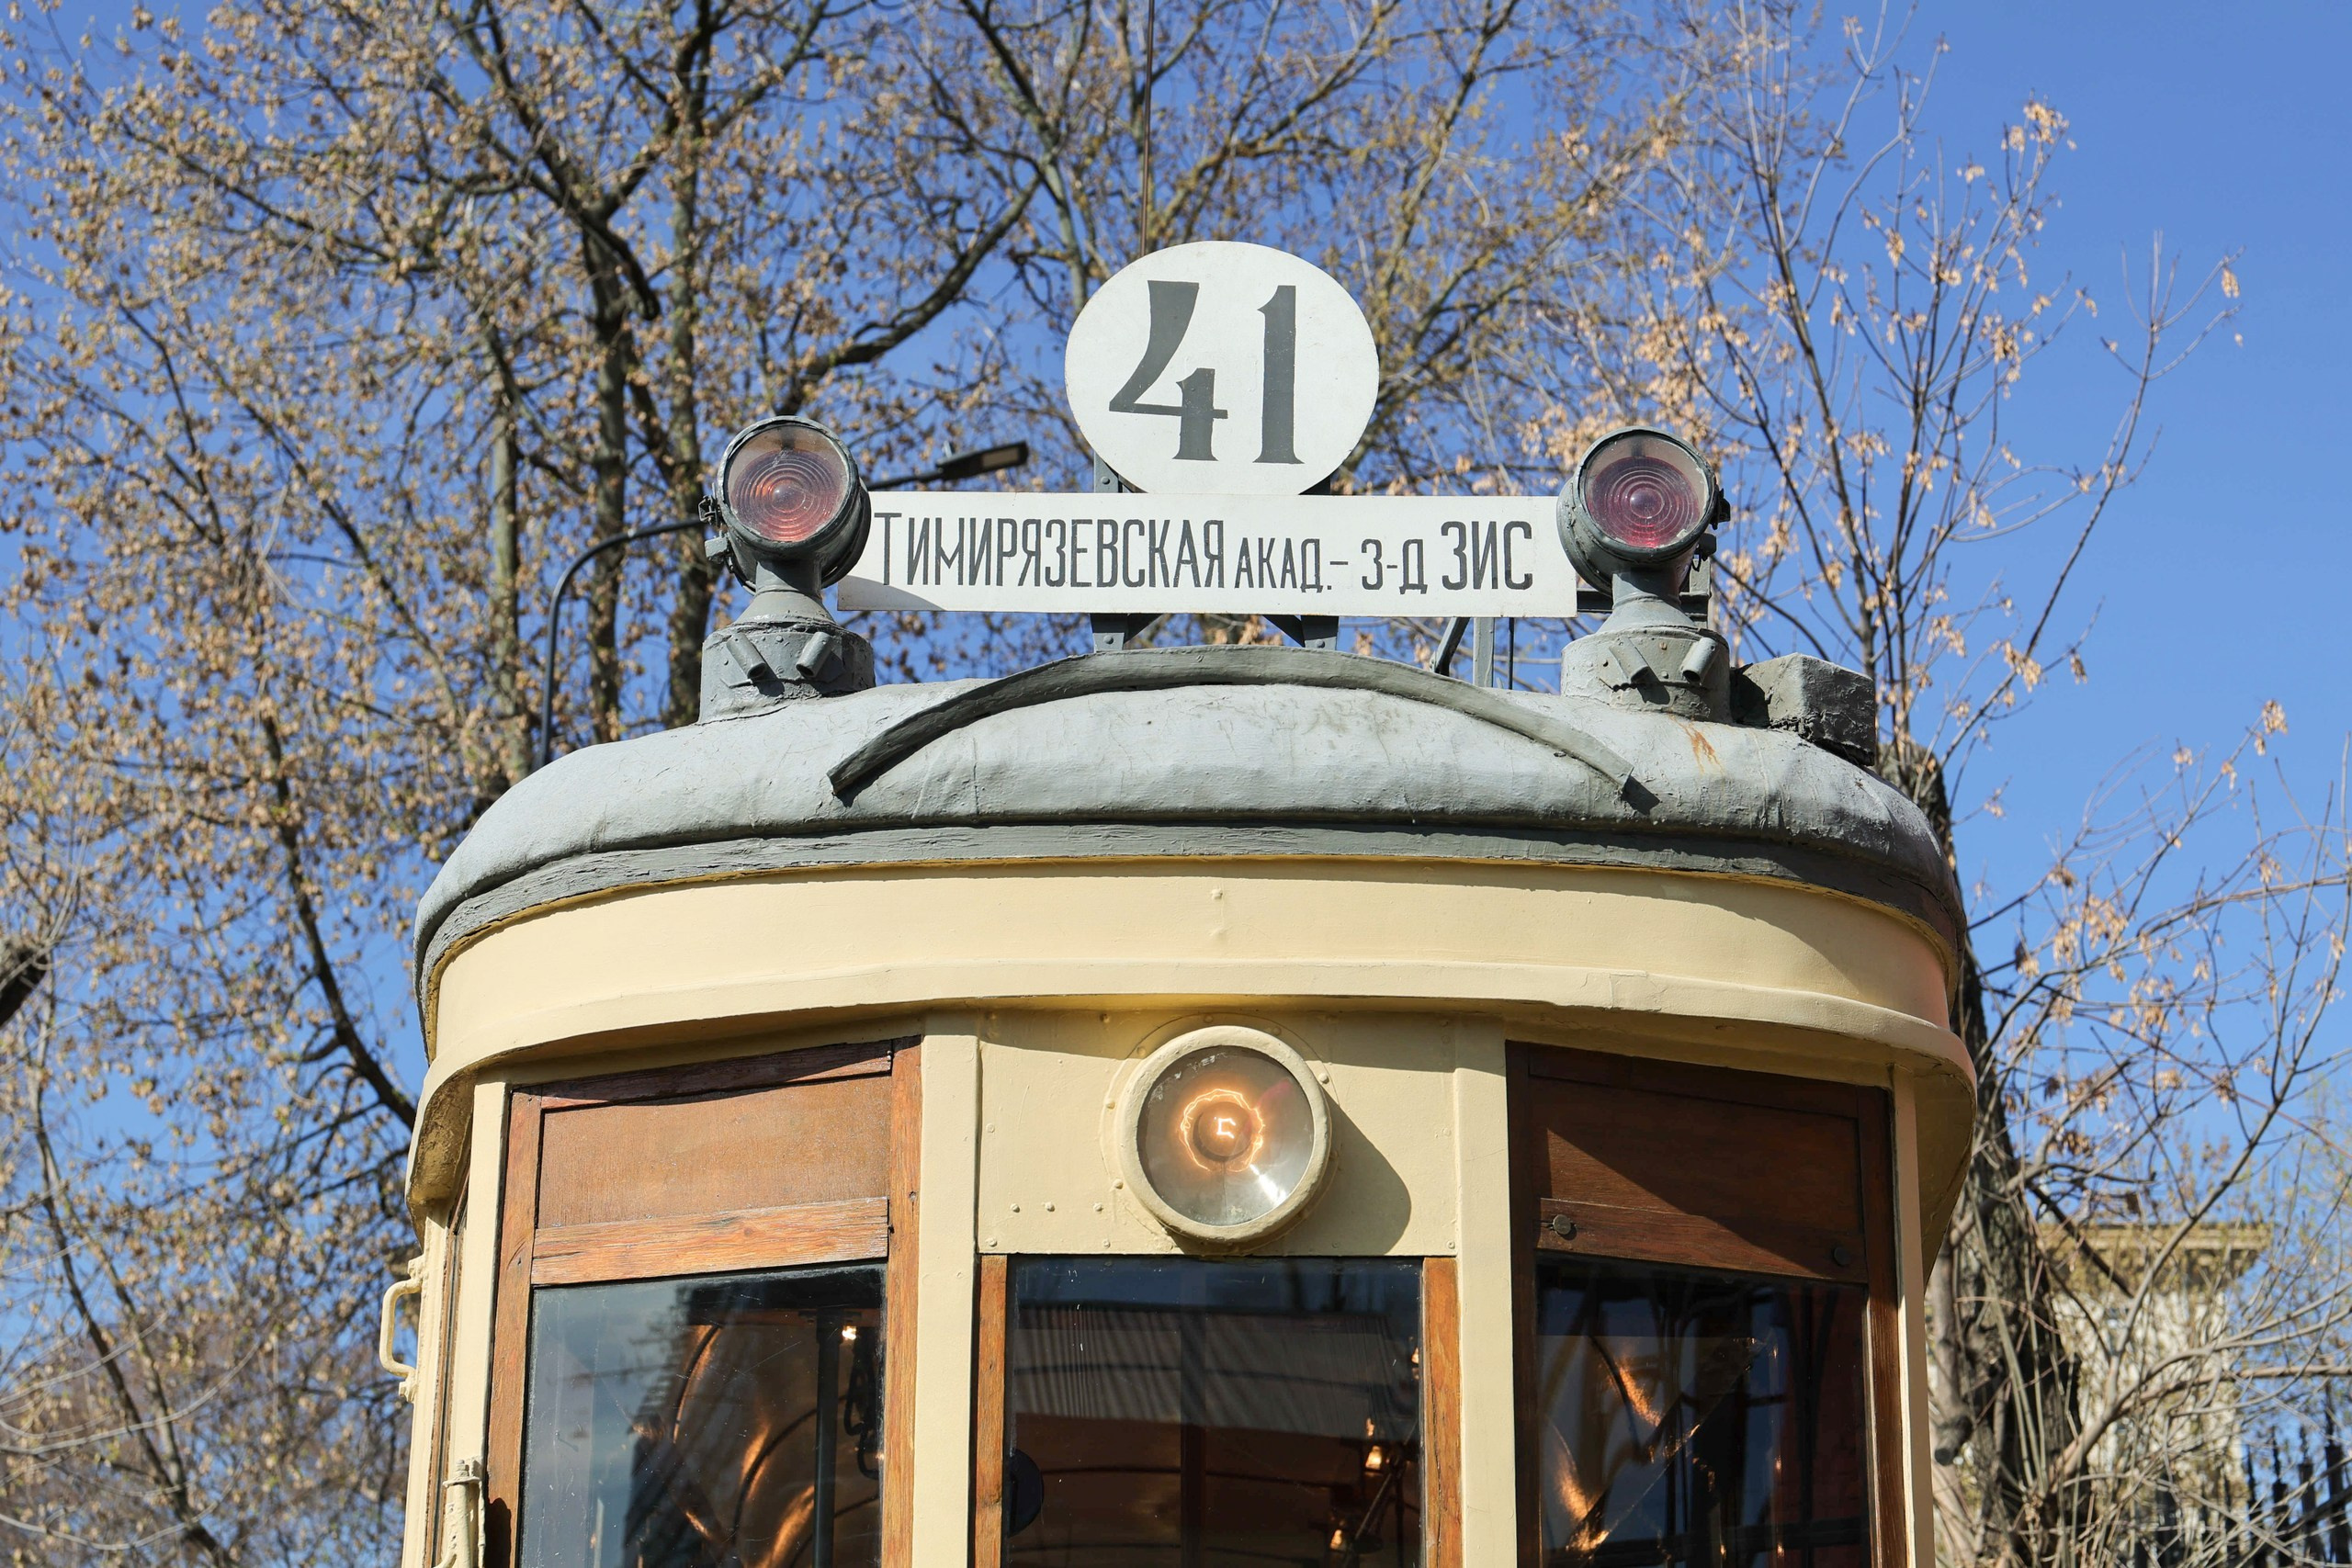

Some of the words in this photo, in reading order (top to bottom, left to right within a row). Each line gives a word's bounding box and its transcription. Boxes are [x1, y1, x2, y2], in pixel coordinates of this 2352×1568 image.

[1109, 279, 1305, 465] 41
[874, 512, 1225, 589] ТИМИРЯЗЕВСКАЯ
[1441, 520, 1533, 591] ЗИС
